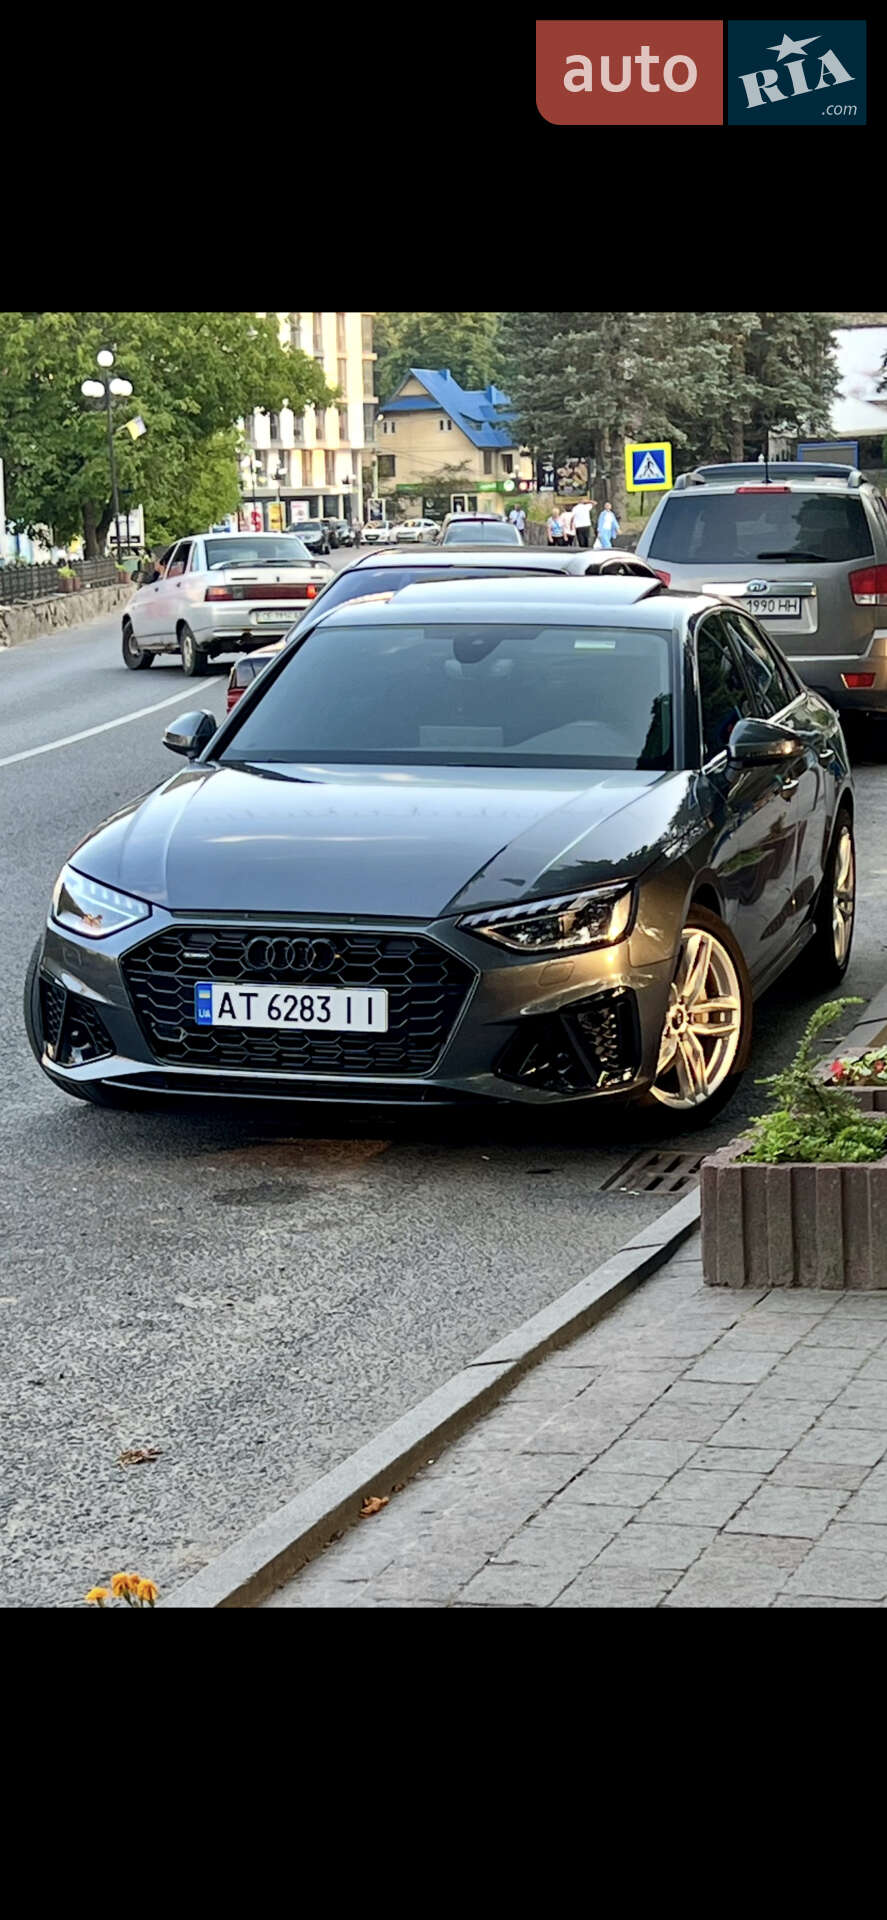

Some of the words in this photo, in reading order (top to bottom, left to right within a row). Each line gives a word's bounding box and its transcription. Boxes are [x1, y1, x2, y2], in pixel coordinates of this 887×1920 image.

[747, 599, 775, 612] 1990
[778, 599, 797, 612] HH
[198, 1008, 211, 1018] UA
[218, 991, 258, 1020] AT
[267, 993, 331, 1023] 6283
